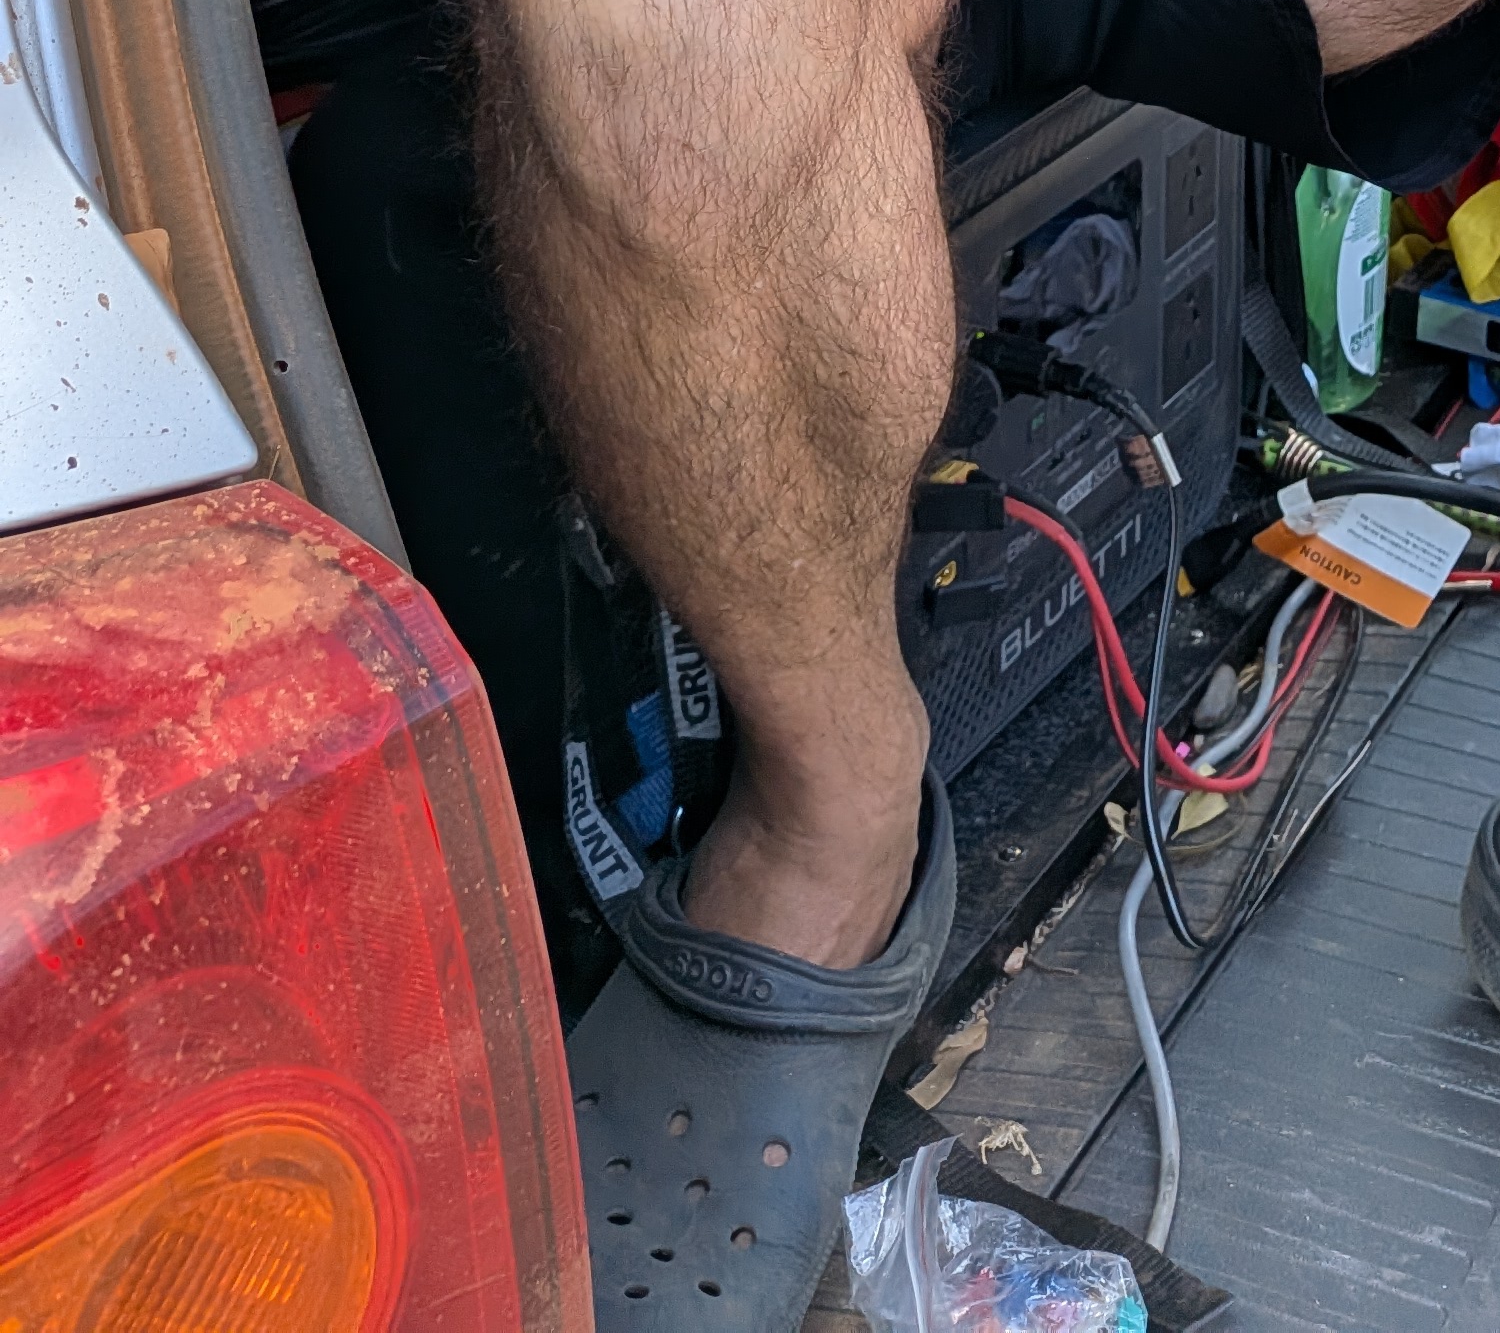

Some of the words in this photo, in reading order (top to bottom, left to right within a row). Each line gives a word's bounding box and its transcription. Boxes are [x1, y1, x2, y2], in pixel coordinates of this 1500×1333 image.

[1299, 542, 1363, 586] CAUTION
[568, 757, 631, 883] GRUNT
[672, 948, 775, 1006] crocs
